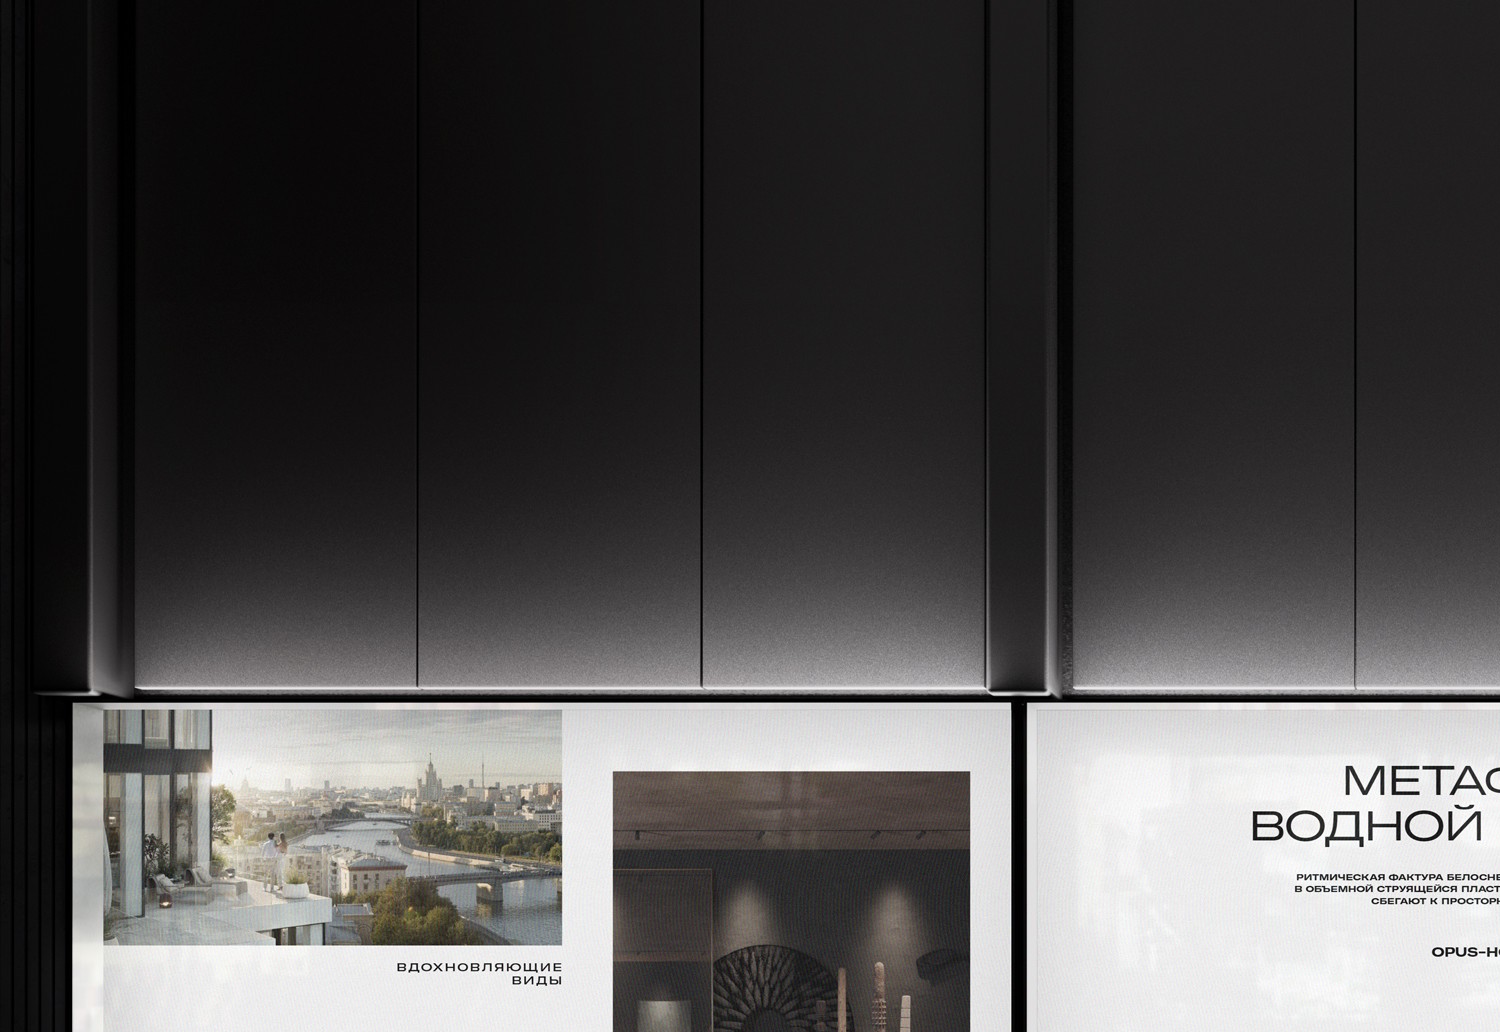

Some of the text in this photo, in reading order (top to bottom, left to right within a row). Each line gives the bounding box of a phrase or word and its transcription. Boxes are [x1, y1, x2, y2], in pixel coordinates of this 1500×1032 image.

[1252, 804, 1482, 848] ВОДНОЙ
[1296, 873, 1386, 882] РИТМИЧЕСКАЯ
[1388, 873, 1444, 882] ФАКТУРА
[1294, 885, 1303, 893] В
[1305, 883, 1374, 893] ОБЪЕМНОЙ
[1376, 883, 1458, 894] СТРУЯЩЕЙСЯ
[1370, 897, 1427, 905] СБЕГАЮТ
[1429, 897, 1438, 905] К
[396, 962, 562, 974] ВДОХНОВЛЯЮЩИЕ
[511, 975, 562, 987] ВИДЫ
